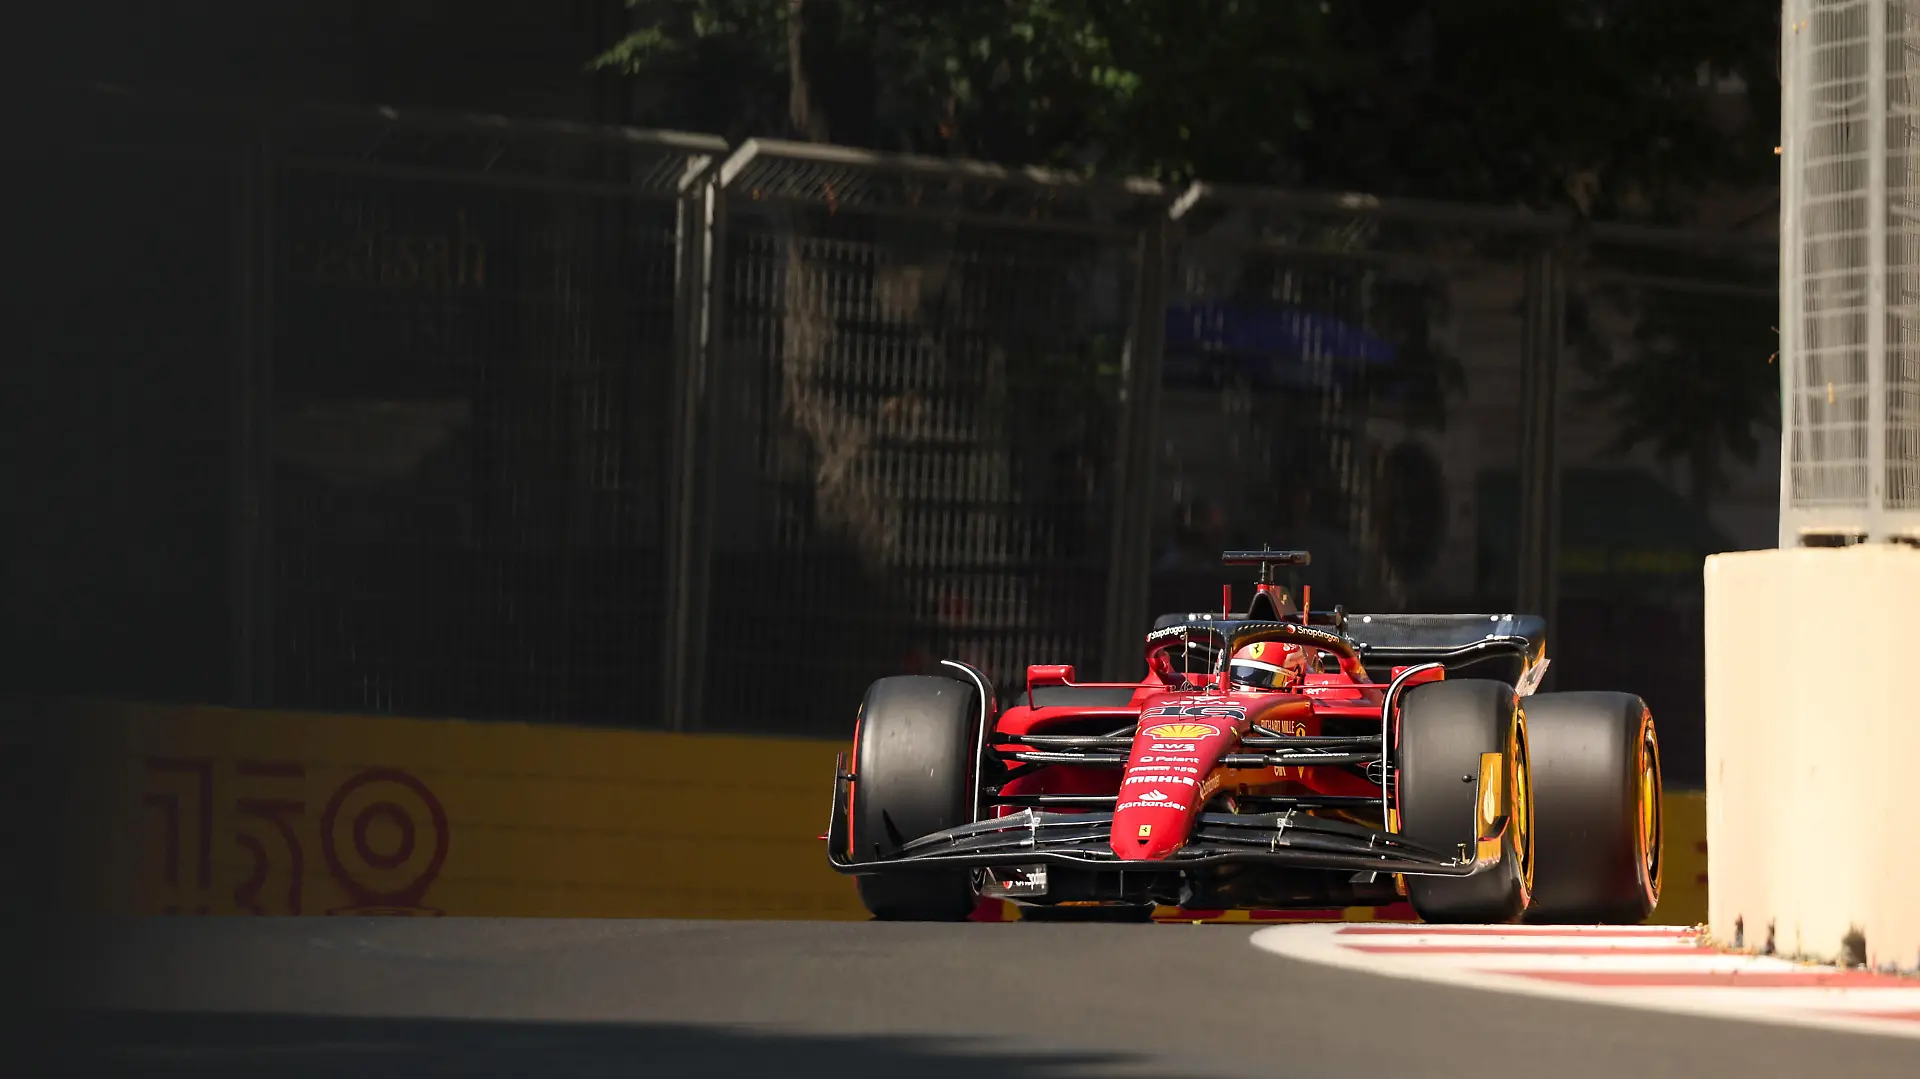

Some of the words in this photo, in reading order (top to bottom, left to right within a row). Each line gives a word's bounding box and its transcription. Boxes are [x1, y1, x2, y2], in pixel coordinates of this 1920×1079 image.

[1151, 625, 1187, 639] Snapdragon
[1297, 625, 1340, 642] Snapdragon
[1281, 720, 1295, 734] MILLE
[1125, 775, 1195, 787] MAHLE
[1117, 800, 1187, 813] Santander
